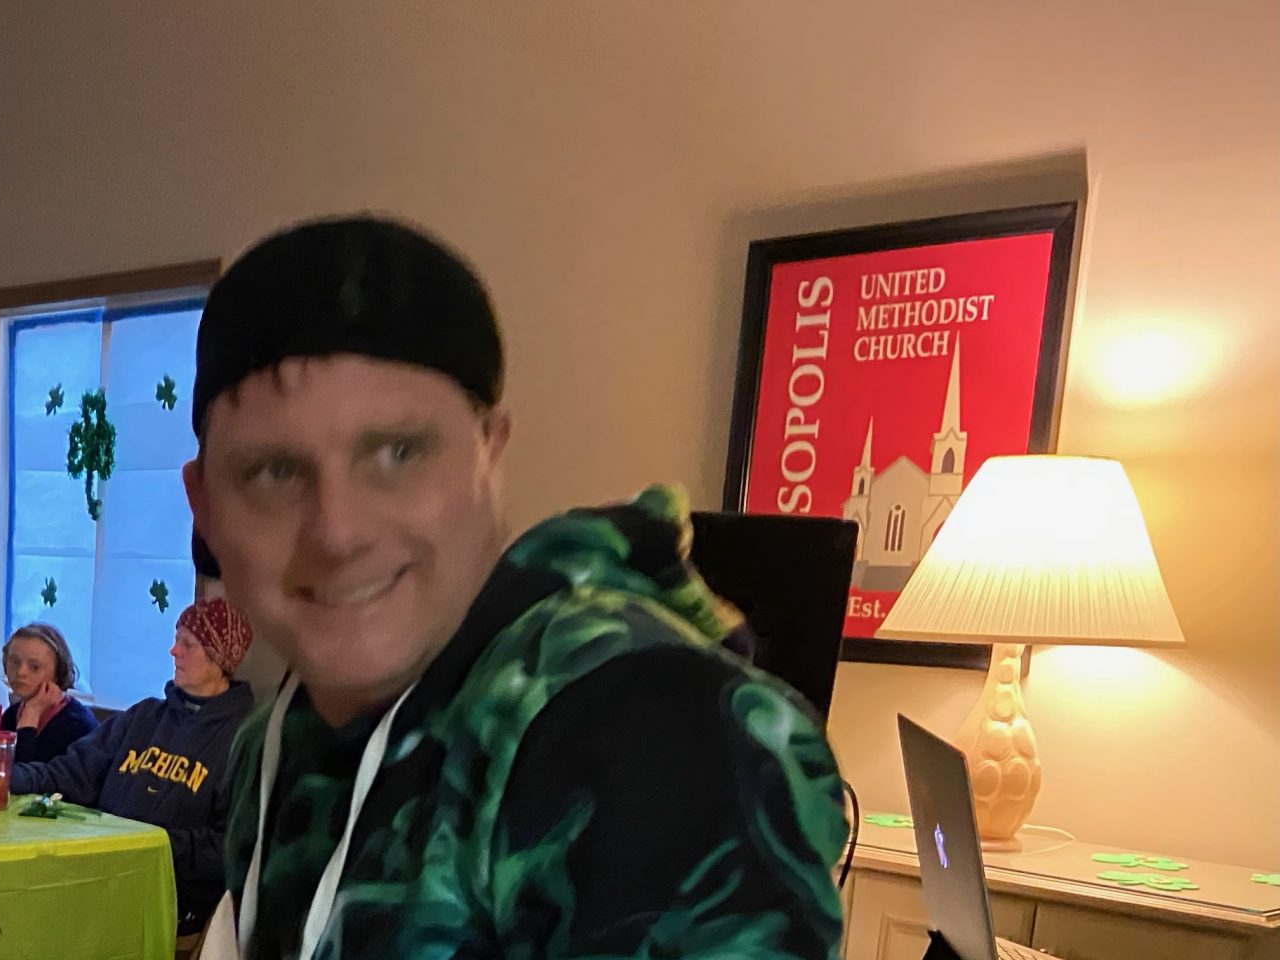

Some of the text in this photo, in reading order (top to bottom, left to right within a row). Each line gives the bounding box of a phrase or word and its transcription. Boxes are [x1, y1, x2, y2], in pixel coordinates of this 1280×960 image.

[860, 267, 946, 300] UNITED
[855, 294, 995, 332] METHODIST
[852, 329, 950, 362] CHURCH
[847, 596, 886, 619] Est.
[118, 745, 209, 794] MCHIGN
